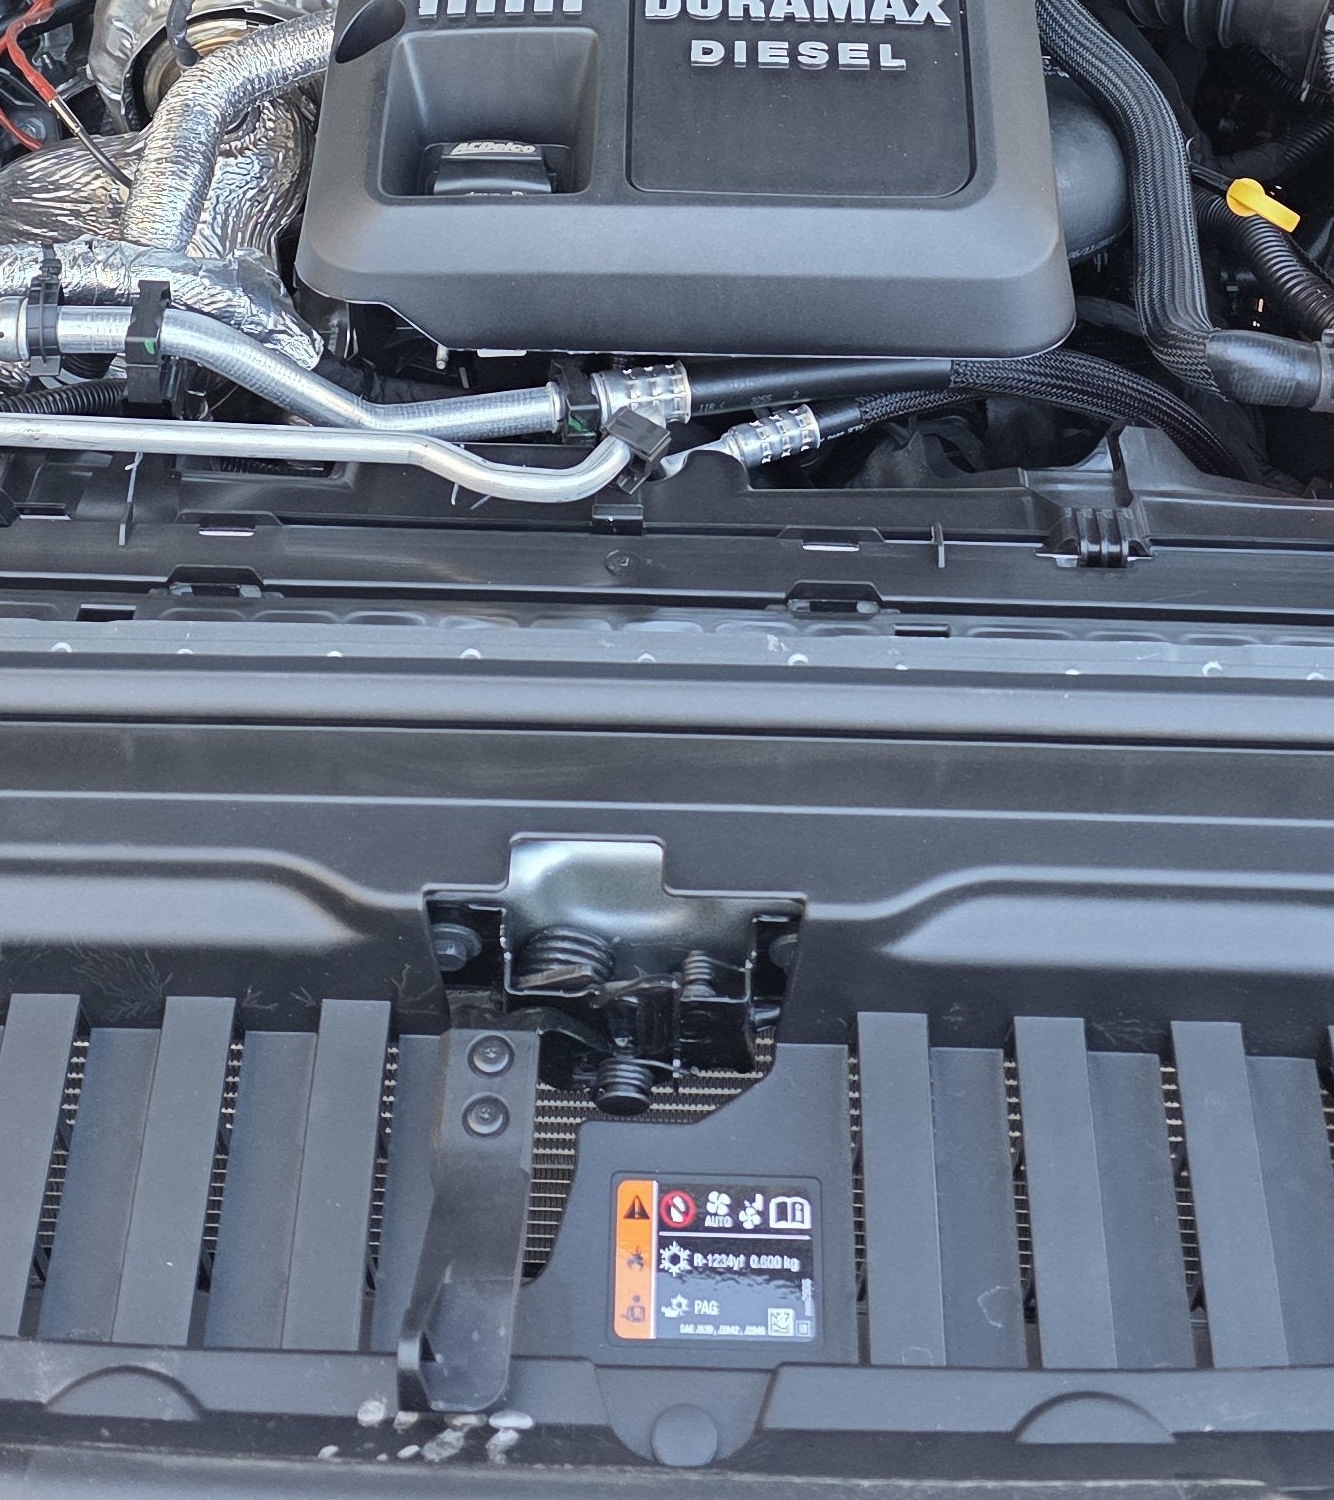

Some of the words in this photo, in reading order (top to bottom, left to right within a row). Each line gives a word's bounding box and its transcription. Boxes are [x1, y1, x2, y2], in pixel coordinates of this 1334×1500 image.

[690, 39, 907, 70] DIESEL
[450, 141, 536, 155] ACDelco
[704, 1215, 733, 1228] AUTO
[693, 1252, 746, 1271] R-1234yf
[783, 1255, 801, 1272] kg
[694, 1299, 720, 1316] PAG
